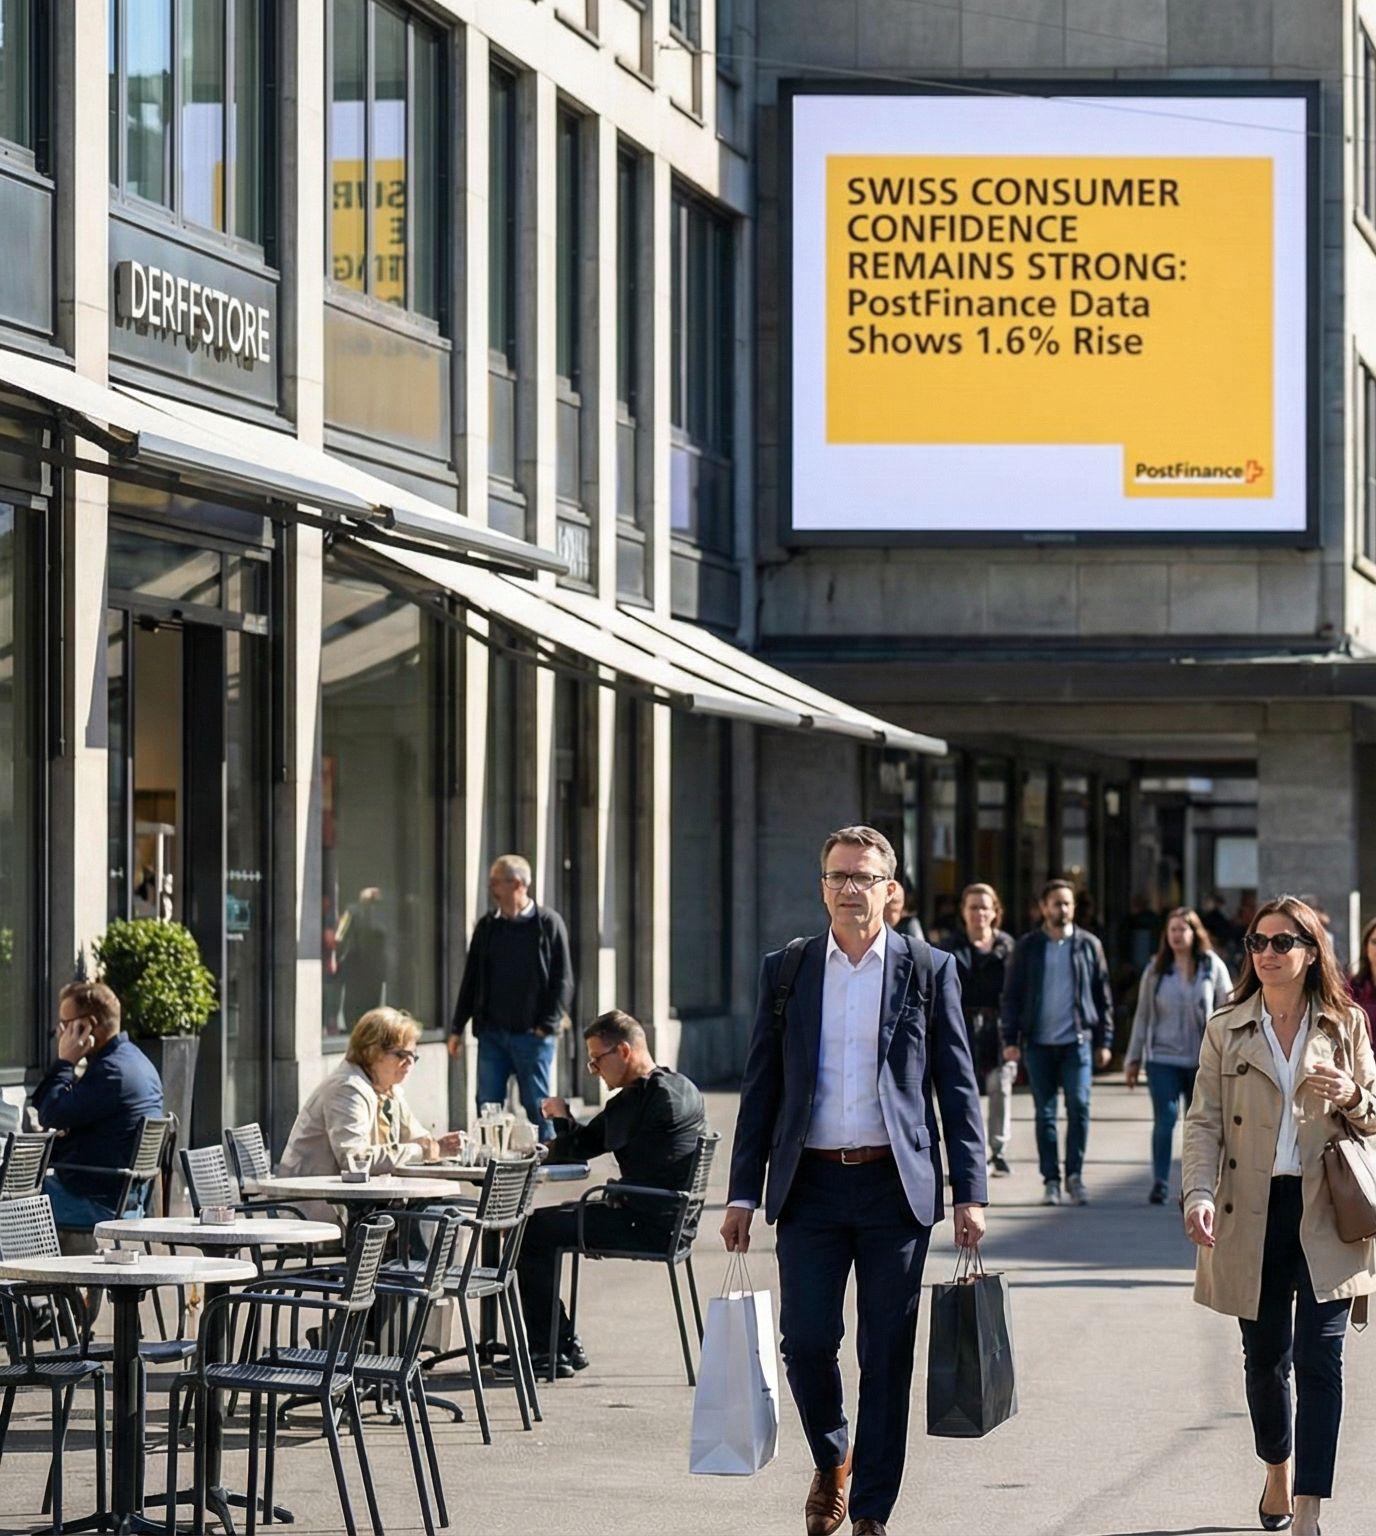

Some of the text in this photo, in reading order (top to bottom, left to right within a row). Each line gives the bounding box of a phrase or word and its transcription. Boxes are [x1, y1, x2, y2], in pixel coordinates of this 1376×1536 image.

[847, 176, 1180, 208] SWISS CONSUMER
[846, 213, 1078, 244] CONFIDENCE
[848, 251, 1187, 282] REMAINS STRONG:
[131, 260, 271, 364] DERFFSTORE
[848, 286, 1150, 319] PostFinance Data
[847, 323, 1144, 356] Shows 1.6% Rise
[1135, 462, 1244, 479] PostFinance
